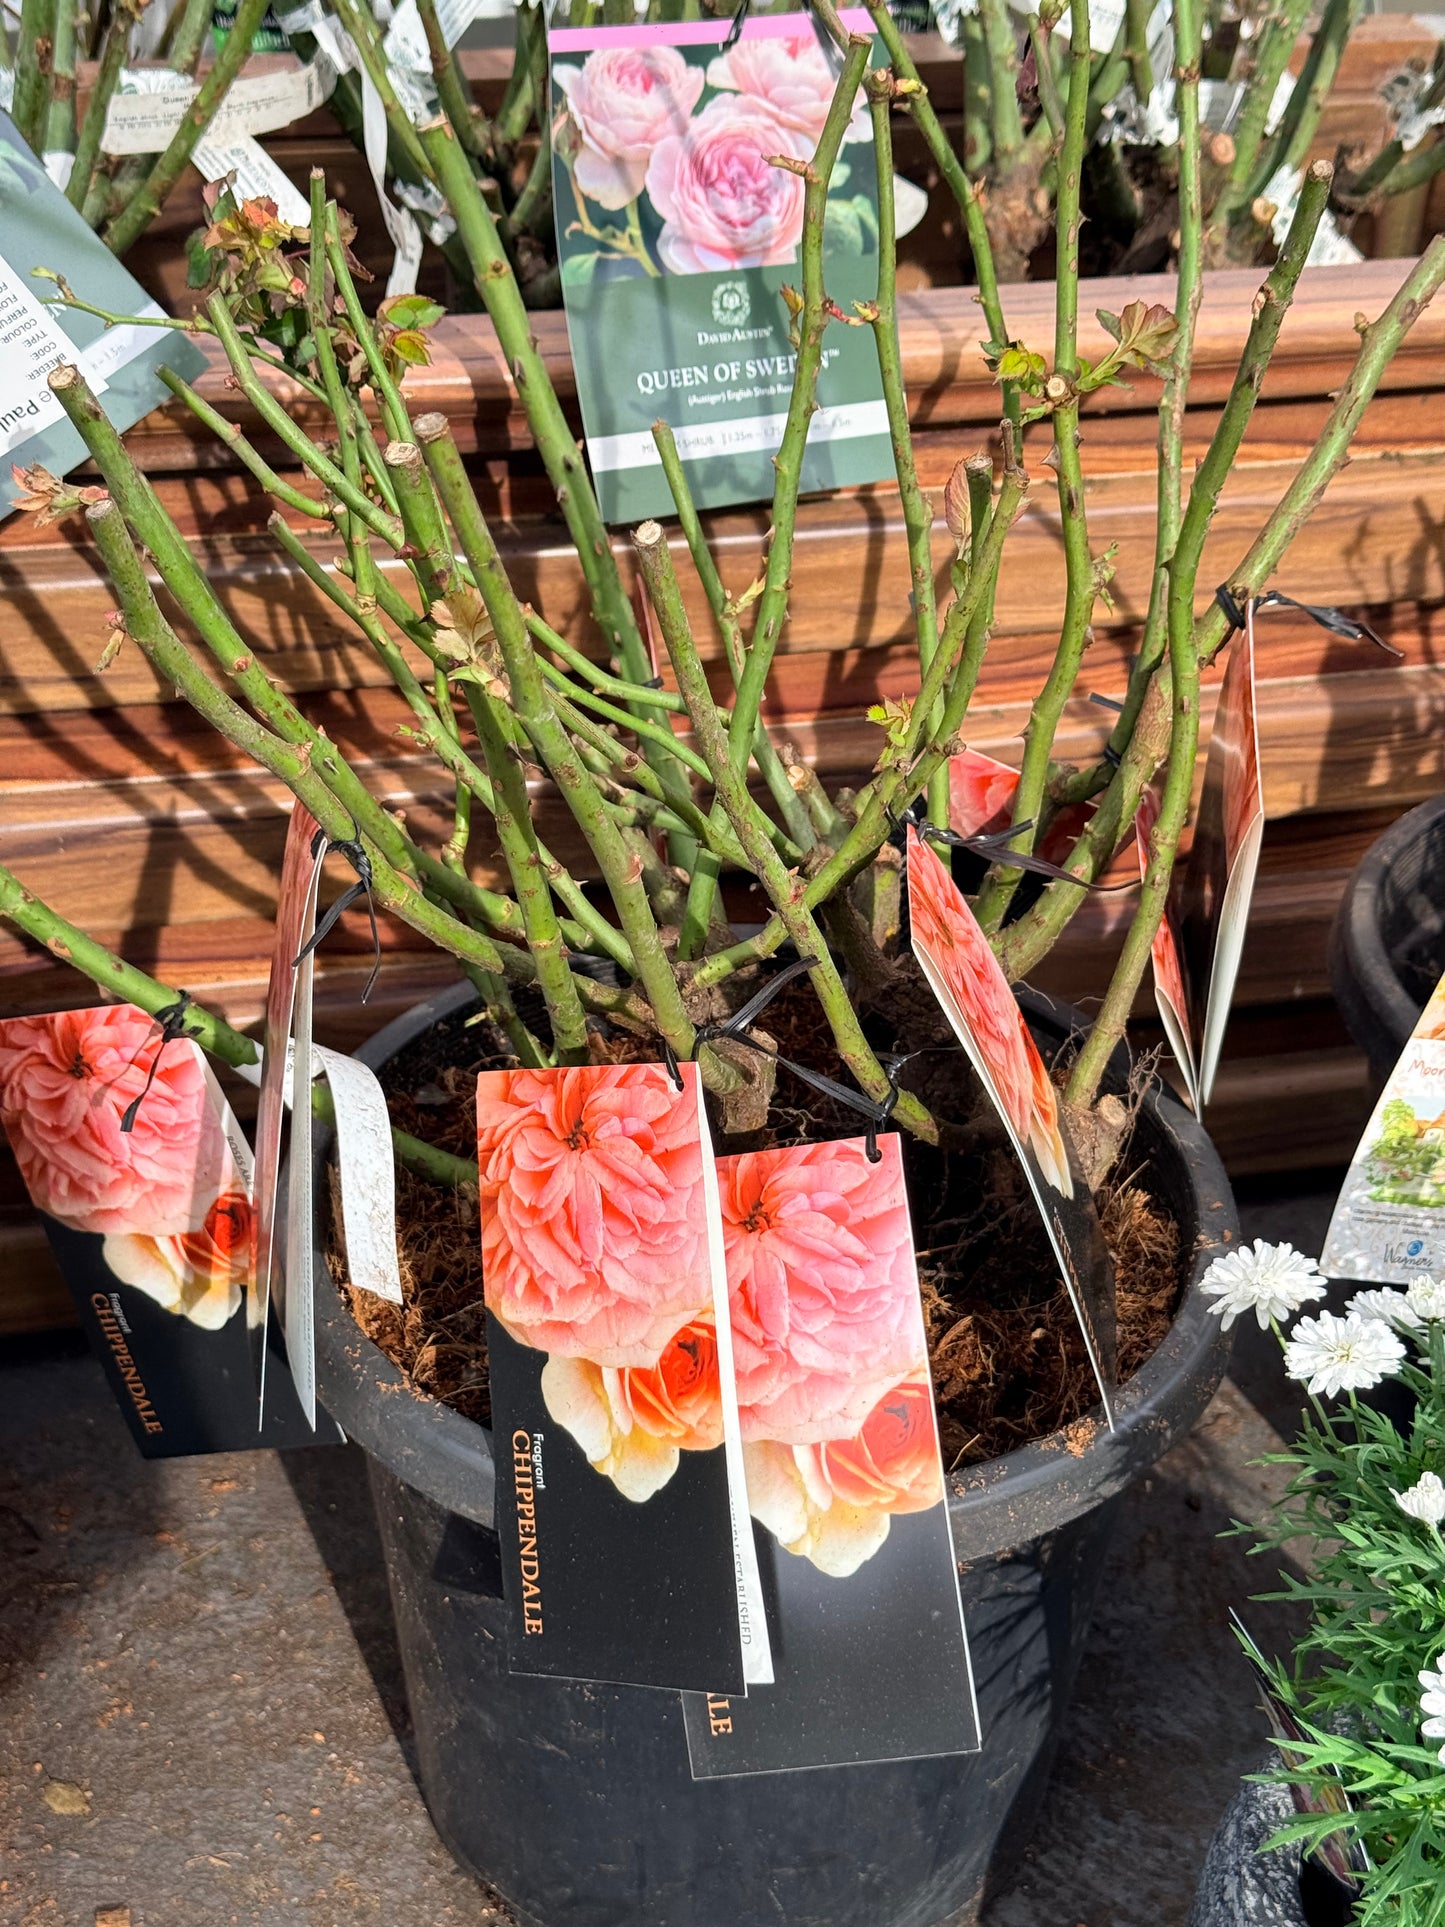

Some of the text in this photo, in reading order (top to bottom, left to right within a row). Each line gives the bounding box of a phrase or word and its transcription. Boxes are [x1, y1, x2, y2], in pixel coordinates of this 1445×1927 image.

[22, 329, 48, 349] TYPE:
[30, 341, 57, 361] CODE:
[636, 365, 709, 396] QUEEN
[713, 360, 741, 383] OF
[108, 1292, 132, 1335] Fragrant
[91, 1292, 163, 1434] CHIPPENDALE
[532, 1432, 546, 1490] Fragrant
[512, 1429, 543, 1635] CHIPPENDALE
